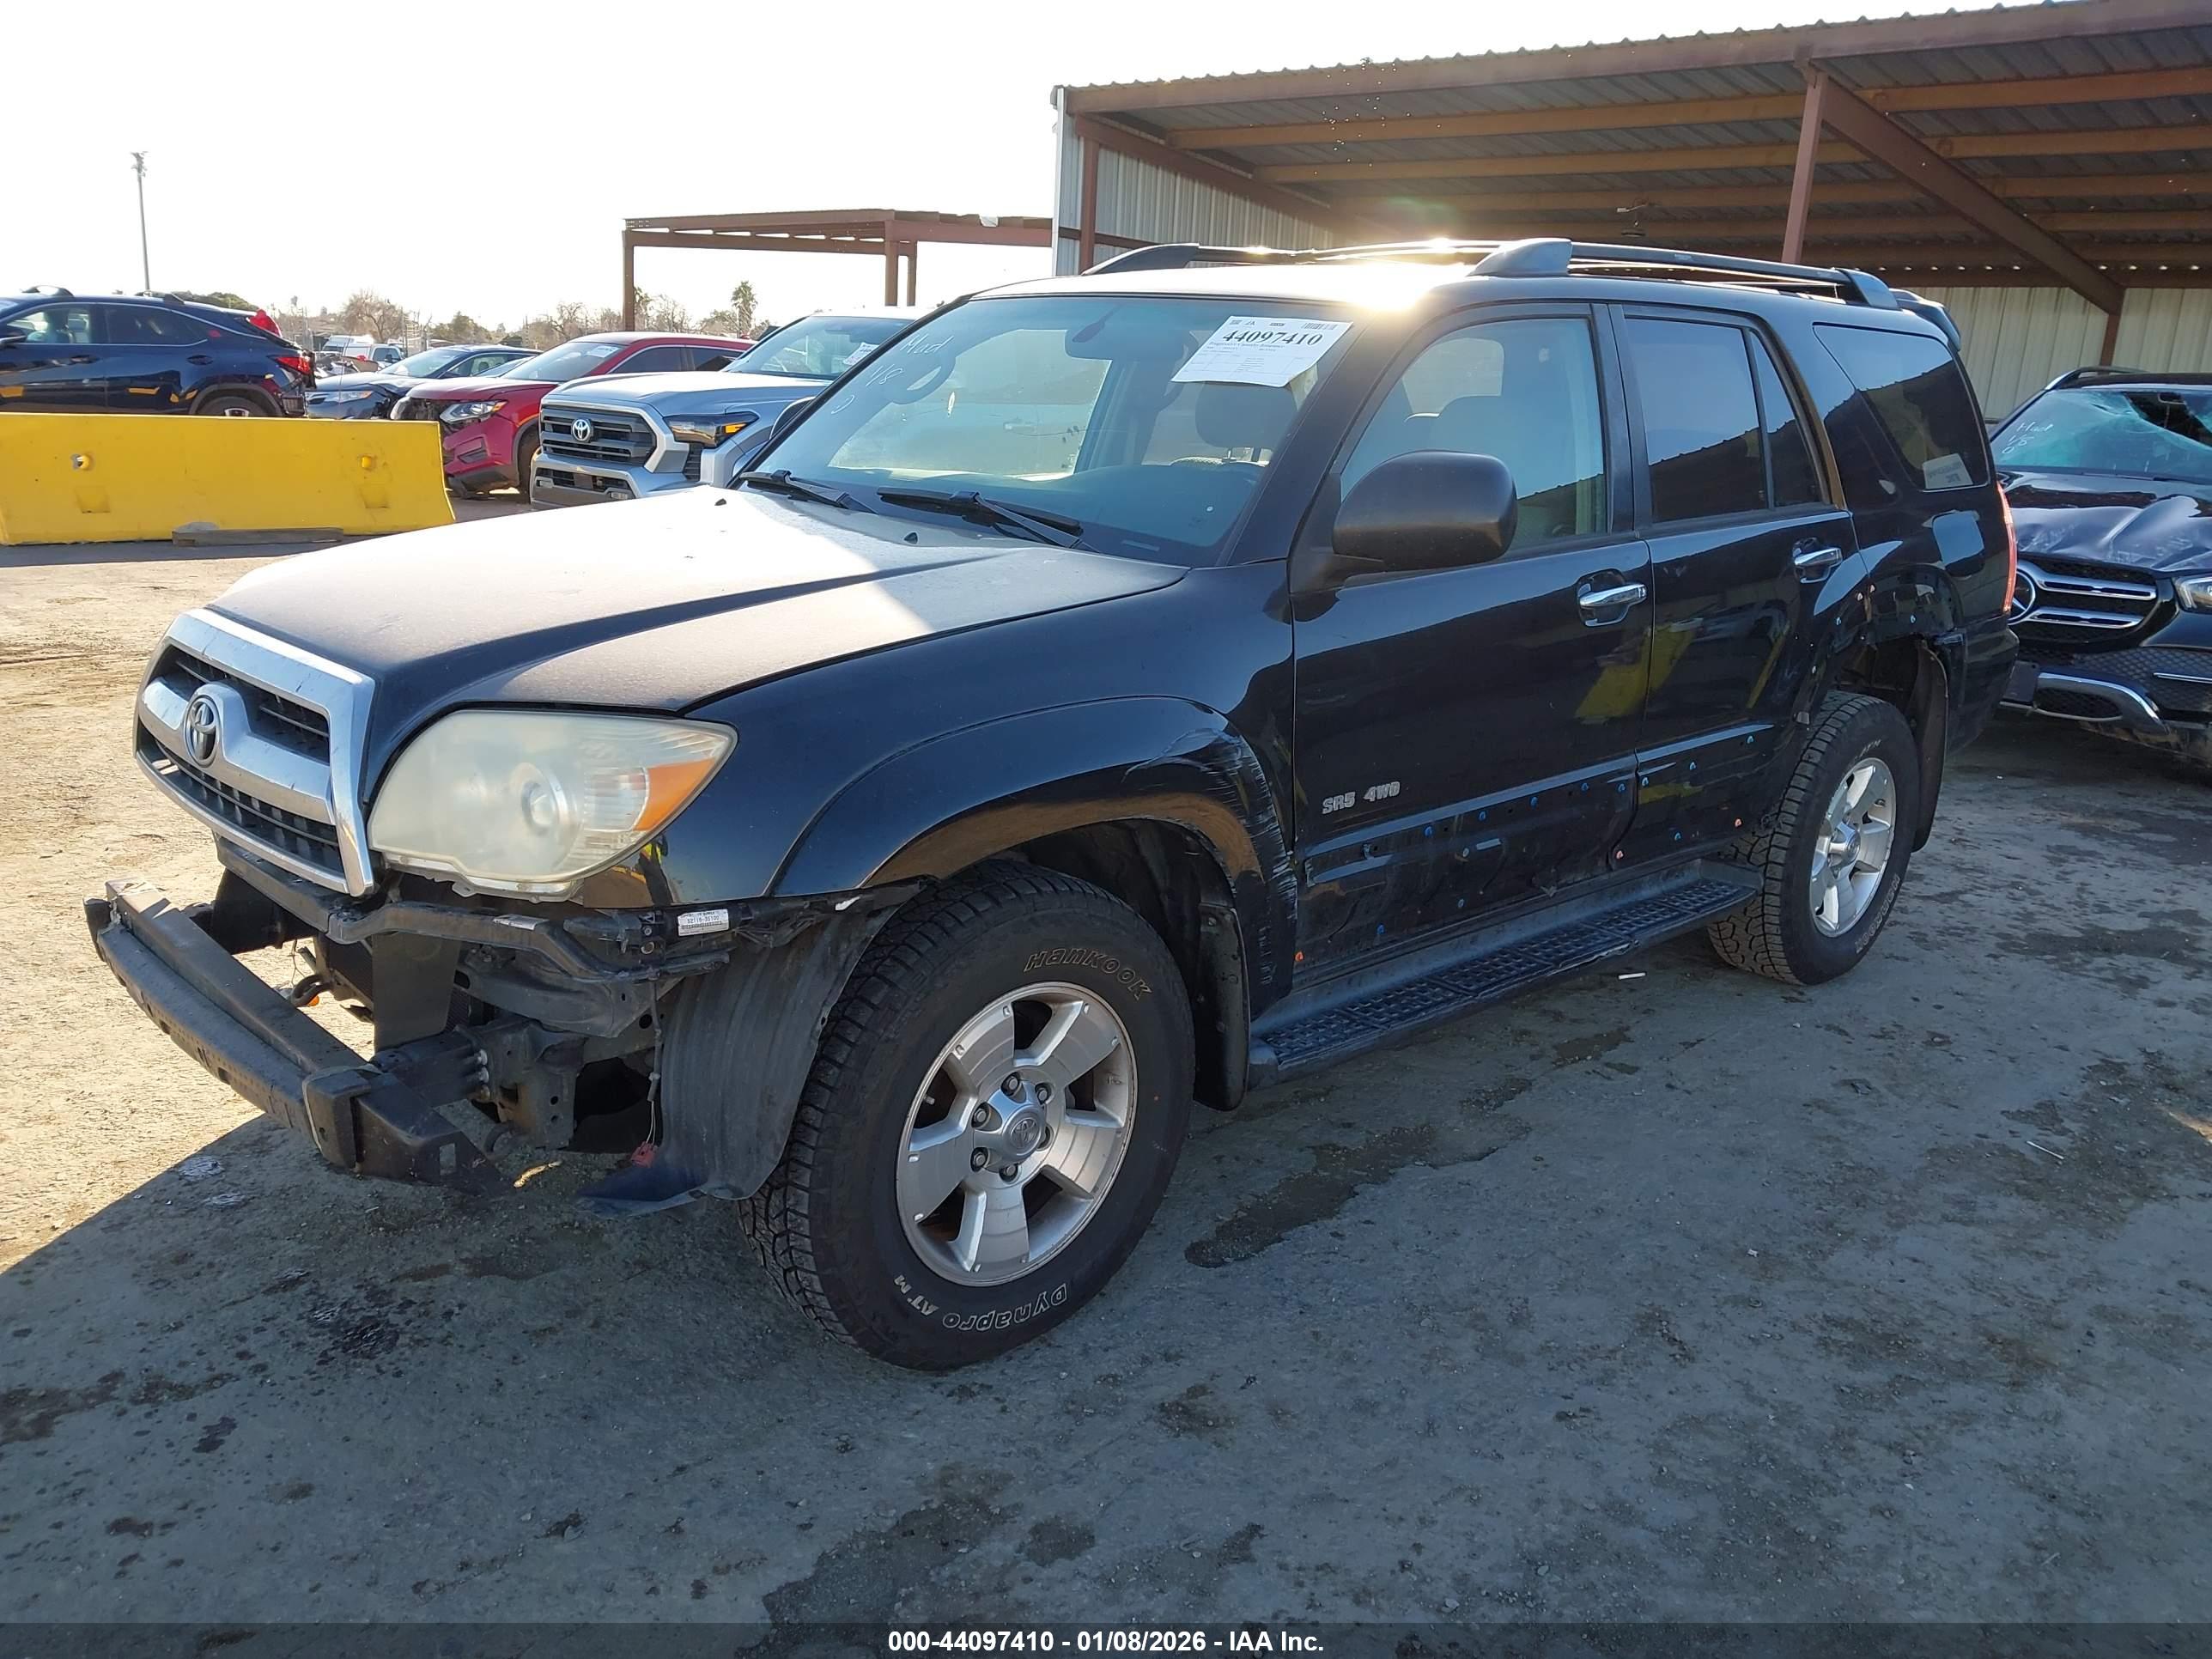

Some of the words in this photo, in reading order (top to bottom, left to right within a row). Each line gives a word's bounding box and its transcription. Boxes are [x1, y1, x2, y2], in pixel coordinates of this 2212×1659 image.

[1223, 329, 1323, 346] 44097410
[1322, 791, 1356, 814] SR5
[1364, 781, 1401, 802] 4WD
[942, 1282, 1068, 1332] Dynapro
